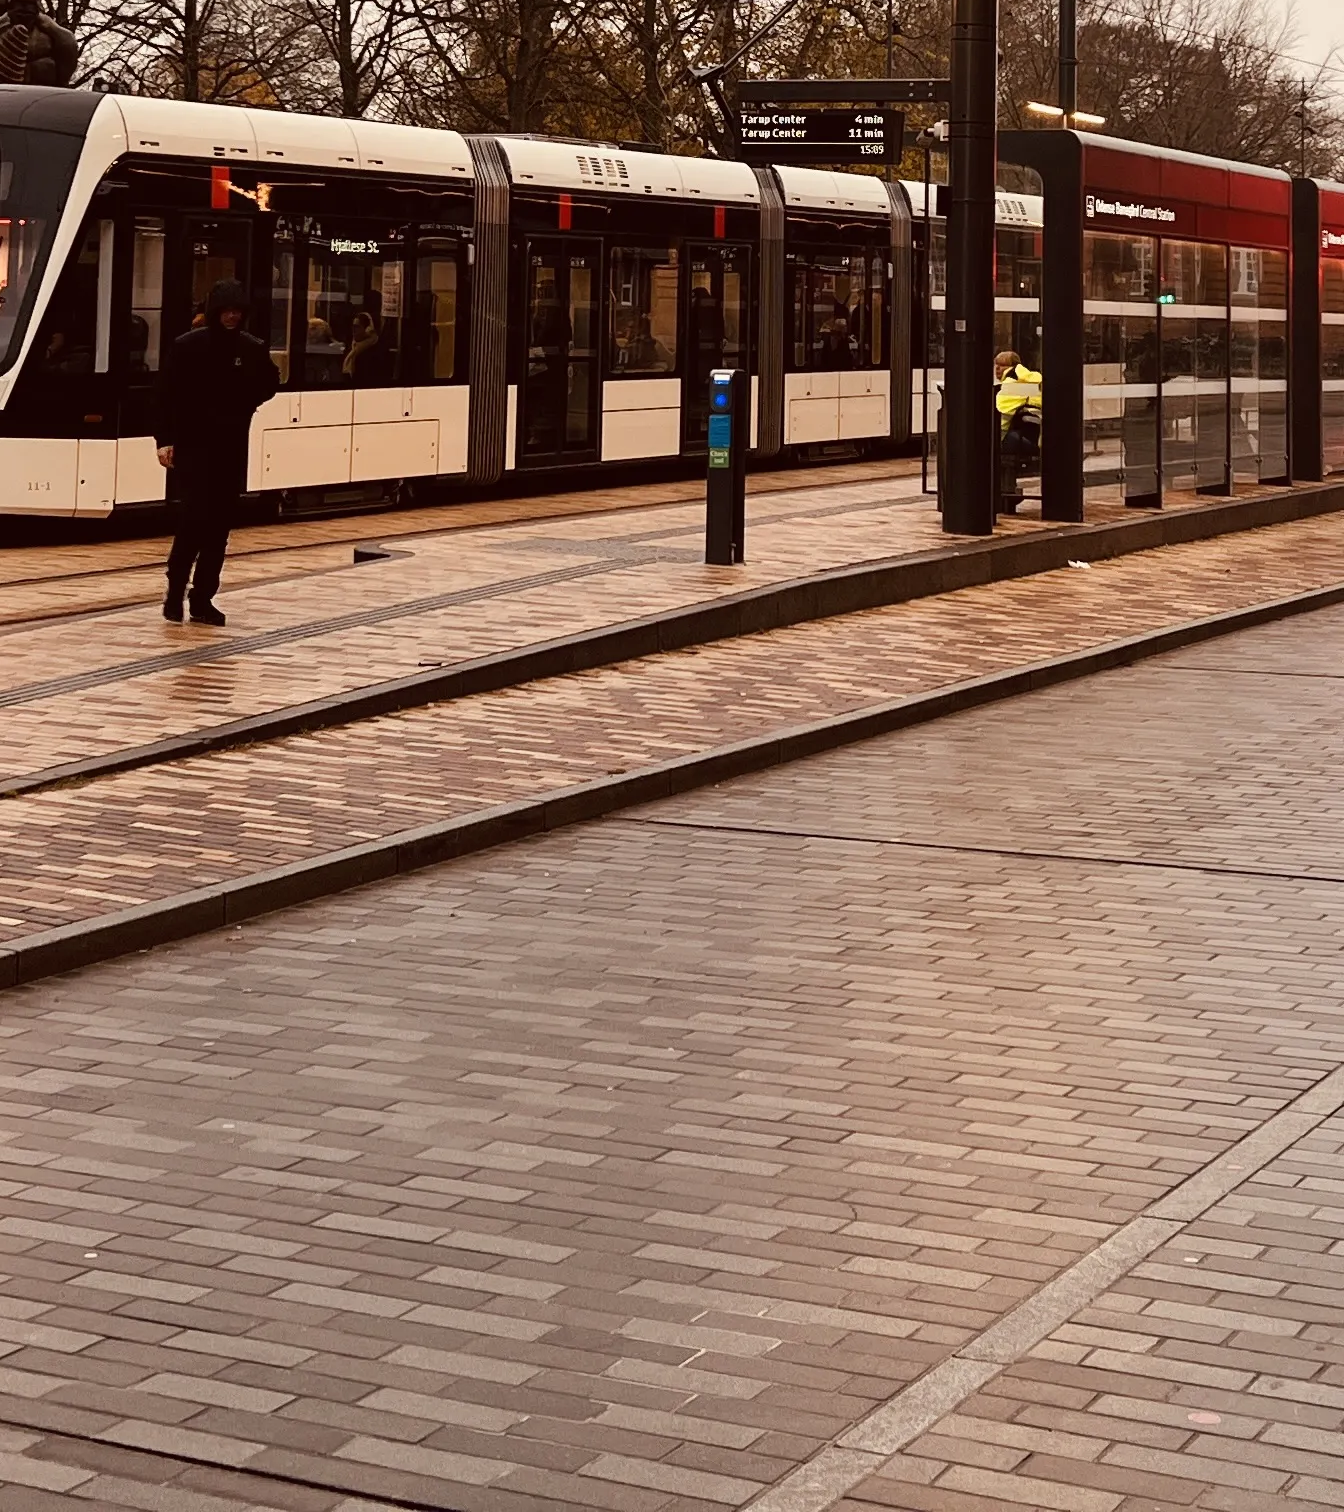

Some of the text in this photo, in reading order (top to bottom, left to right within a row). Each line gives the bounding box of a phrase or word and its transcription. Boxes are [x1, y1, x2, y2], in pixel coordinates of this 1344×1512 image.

[741, 115, 883, 125] Tarup Center 4 min
[741, 128, 883, 139] Tarup Center 11 min
[331, 238, 365, 255] Hjallese
[28, 482, 50, 490] 11-1
